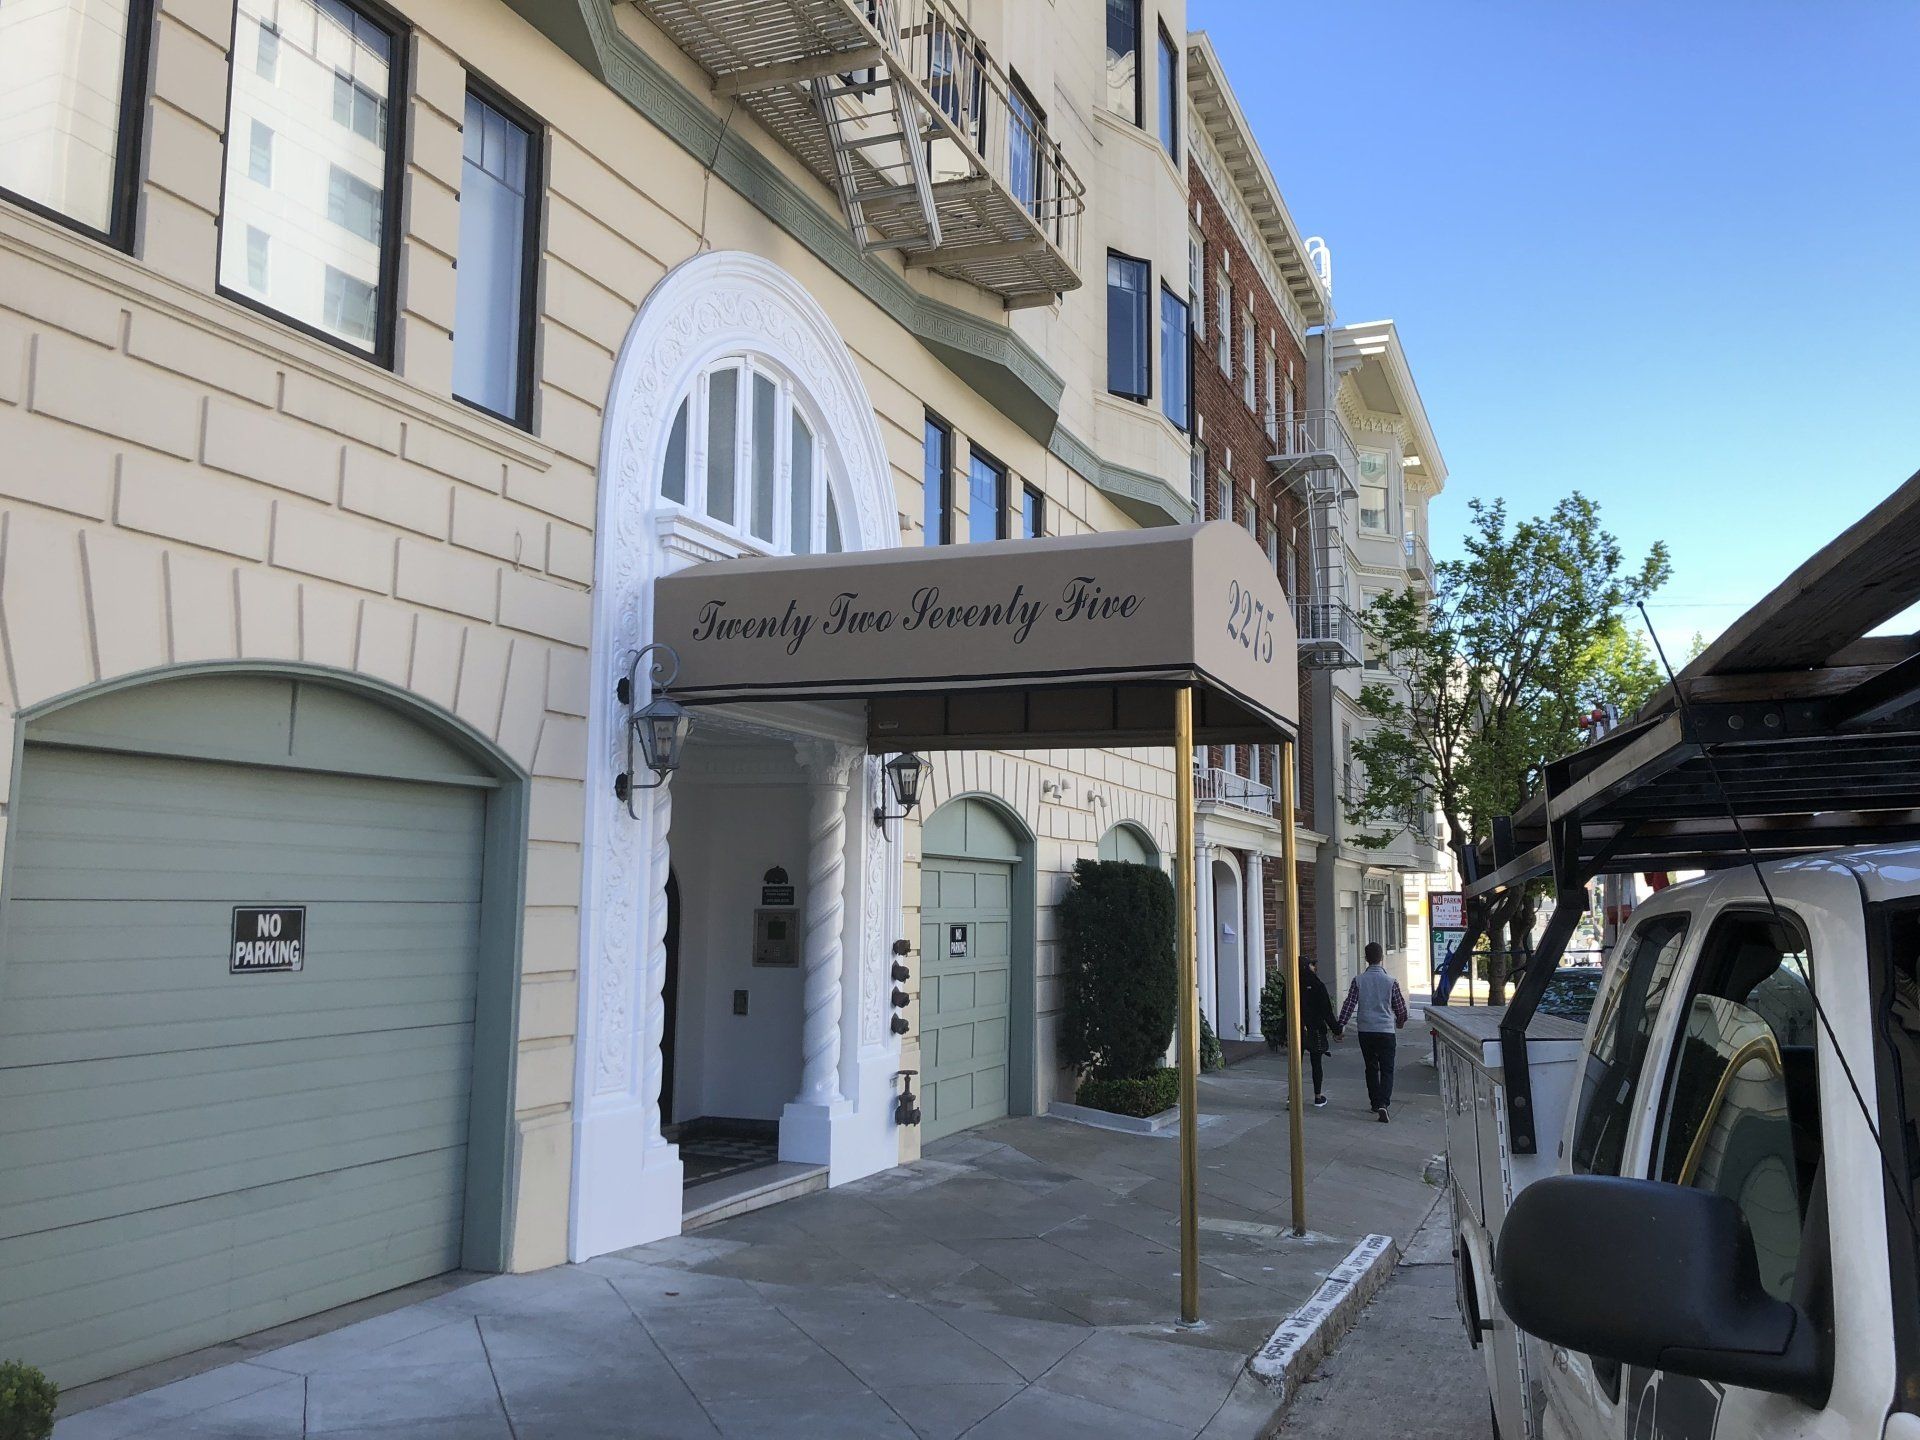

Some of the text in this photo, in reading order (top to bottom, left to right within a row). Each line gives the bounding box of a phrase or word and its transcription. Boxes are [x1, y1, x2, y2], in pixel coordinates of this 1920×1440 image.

[692, 576, 1146, 656] Twenty Two Seventy Five
[1227, 579, 1275, 664] 2275
[1432, 895, 1442, 904] NO
[257, 913, 282, 938] NO
[955, 928, 963, 941] NO
[1435, 932, 1442, 942] 2
[234, 939, 300, 966] PARKING
[950, 941, 967, 954] PARKING
